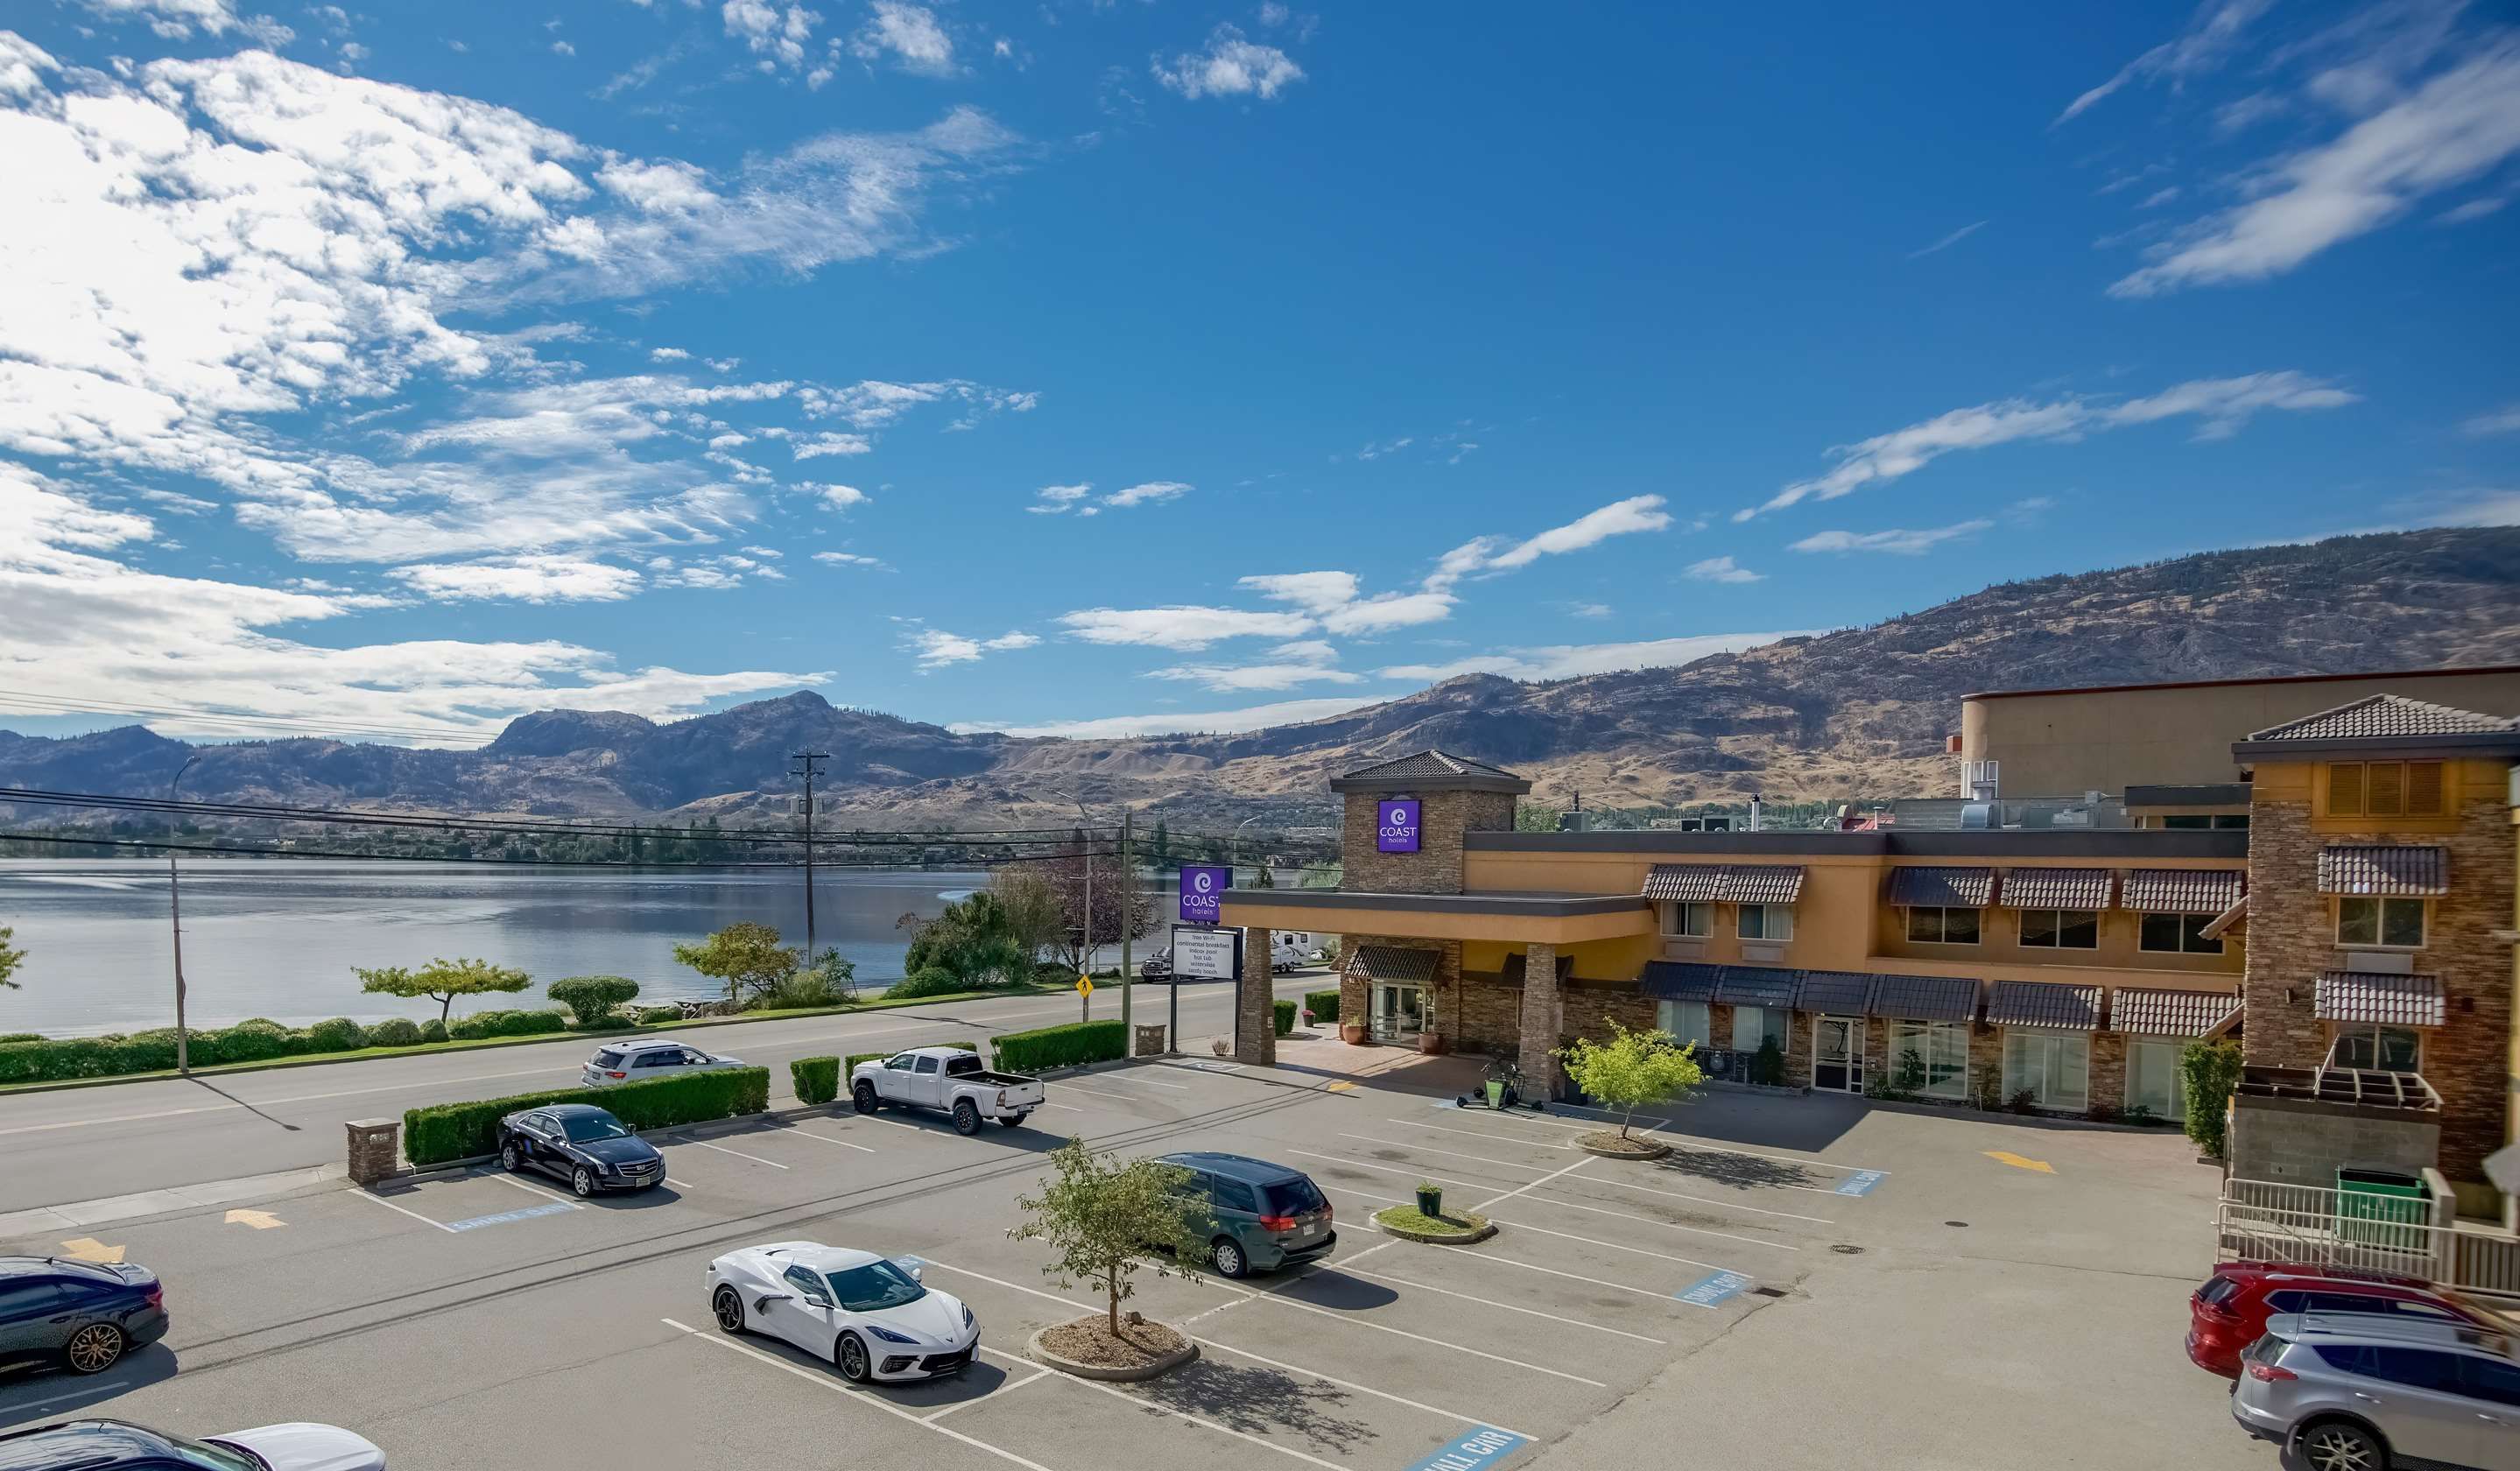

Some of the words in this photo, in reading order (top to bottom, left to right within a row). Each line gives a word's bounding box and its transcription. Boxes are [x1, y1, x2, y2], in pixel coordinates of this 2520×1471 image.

[1380, 827, 1417, 836] COAST
[1683, 1284, 1730, 1302] SMALL
[1713, 1274, 1747, 1289] CAR
[1461, 1431, 1513, 1455] CAR
